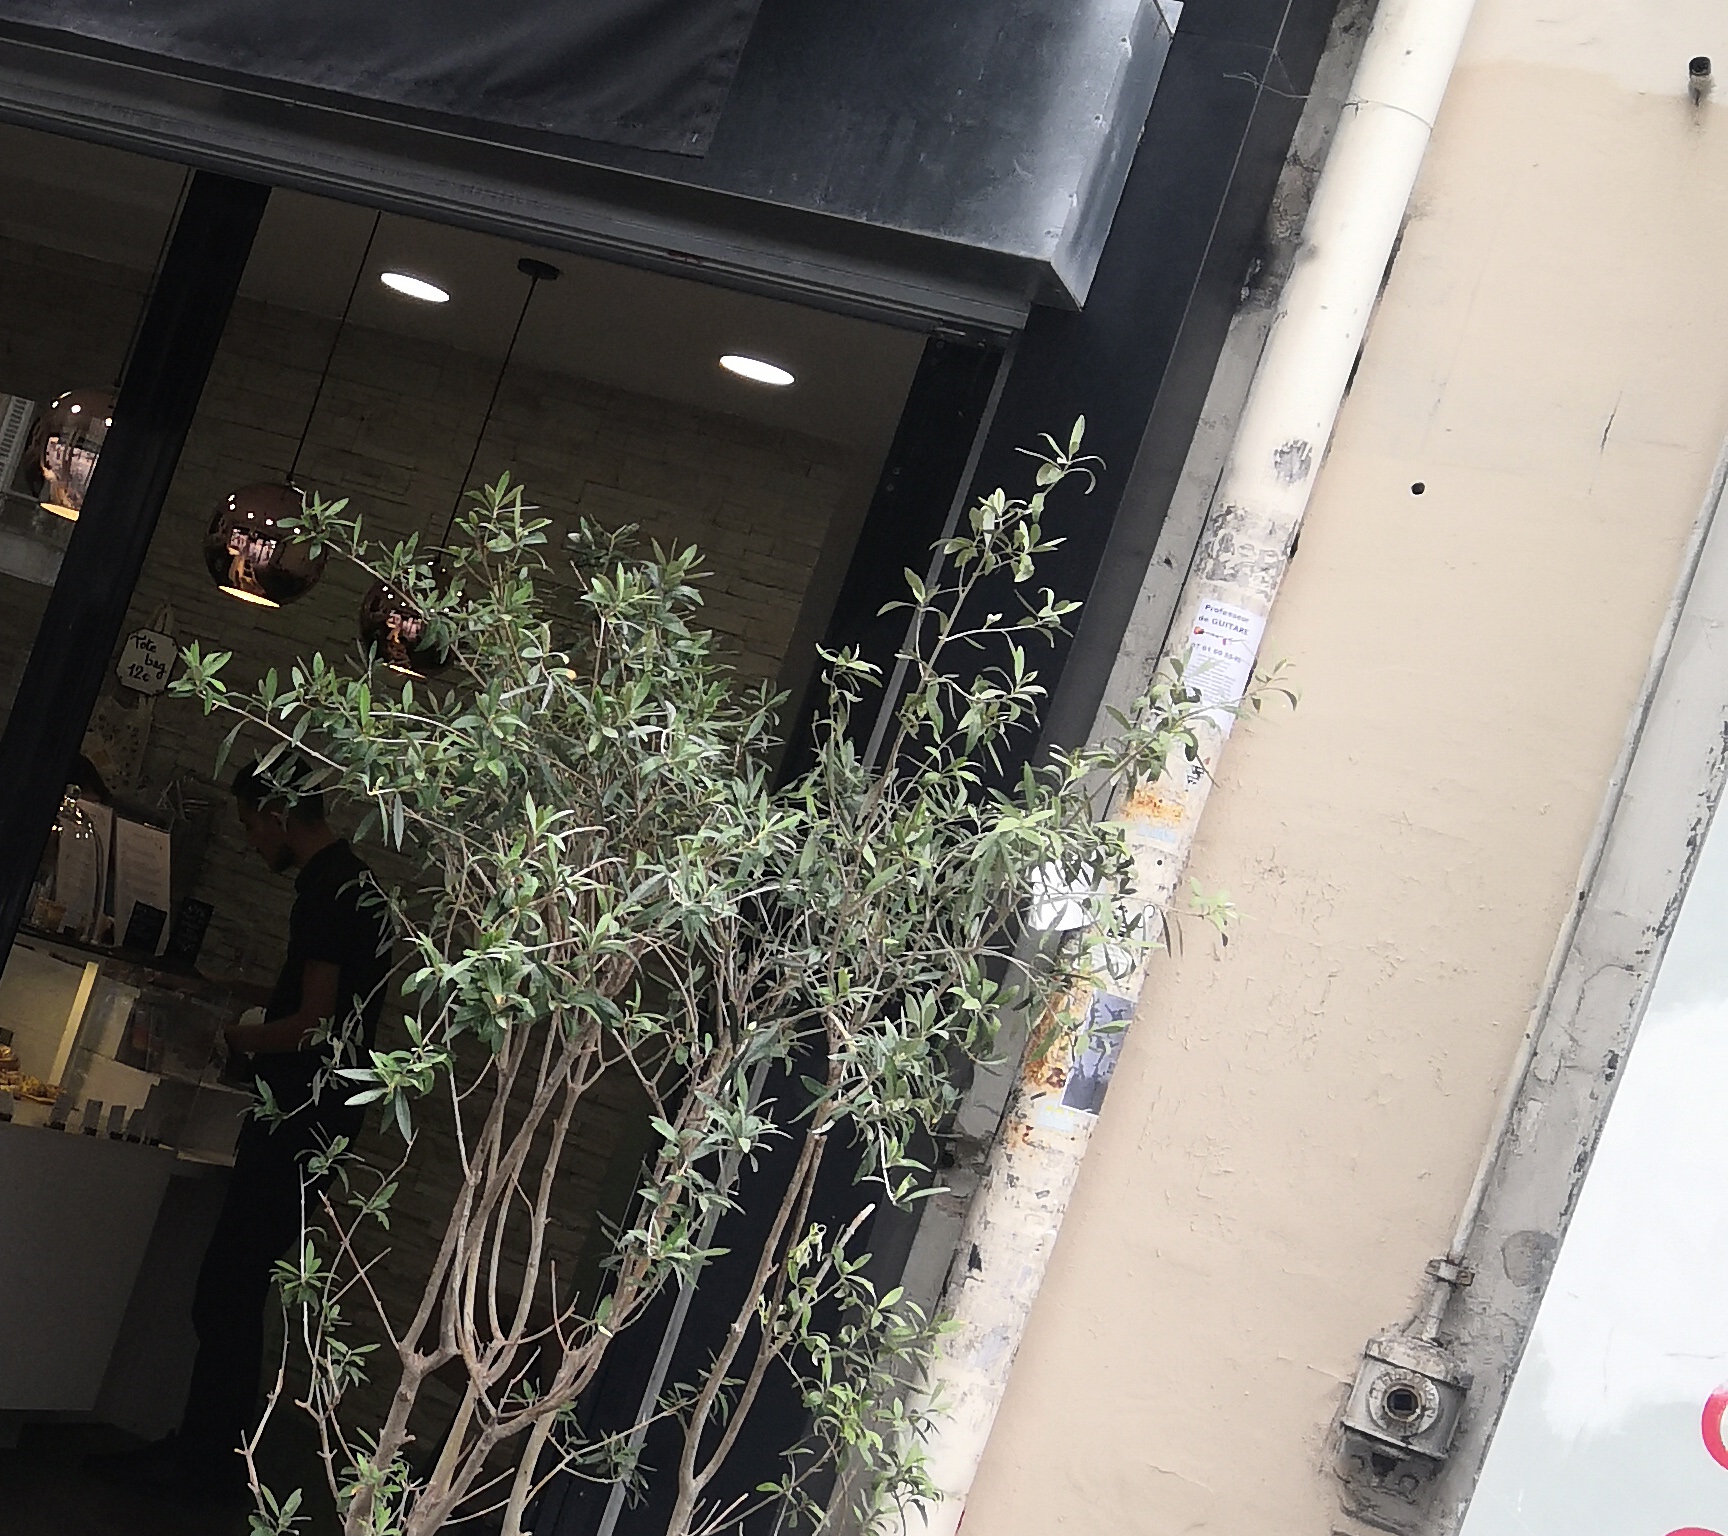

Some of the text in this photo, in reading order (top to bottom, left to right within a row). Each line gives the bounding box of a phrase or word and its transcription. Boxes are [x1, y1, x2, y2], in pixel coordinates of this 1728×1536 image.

[1211, 618, 1249, 636] GUITARE
[130, 634, 157, 653] Tote
[144, 653, 166, 680] bag
